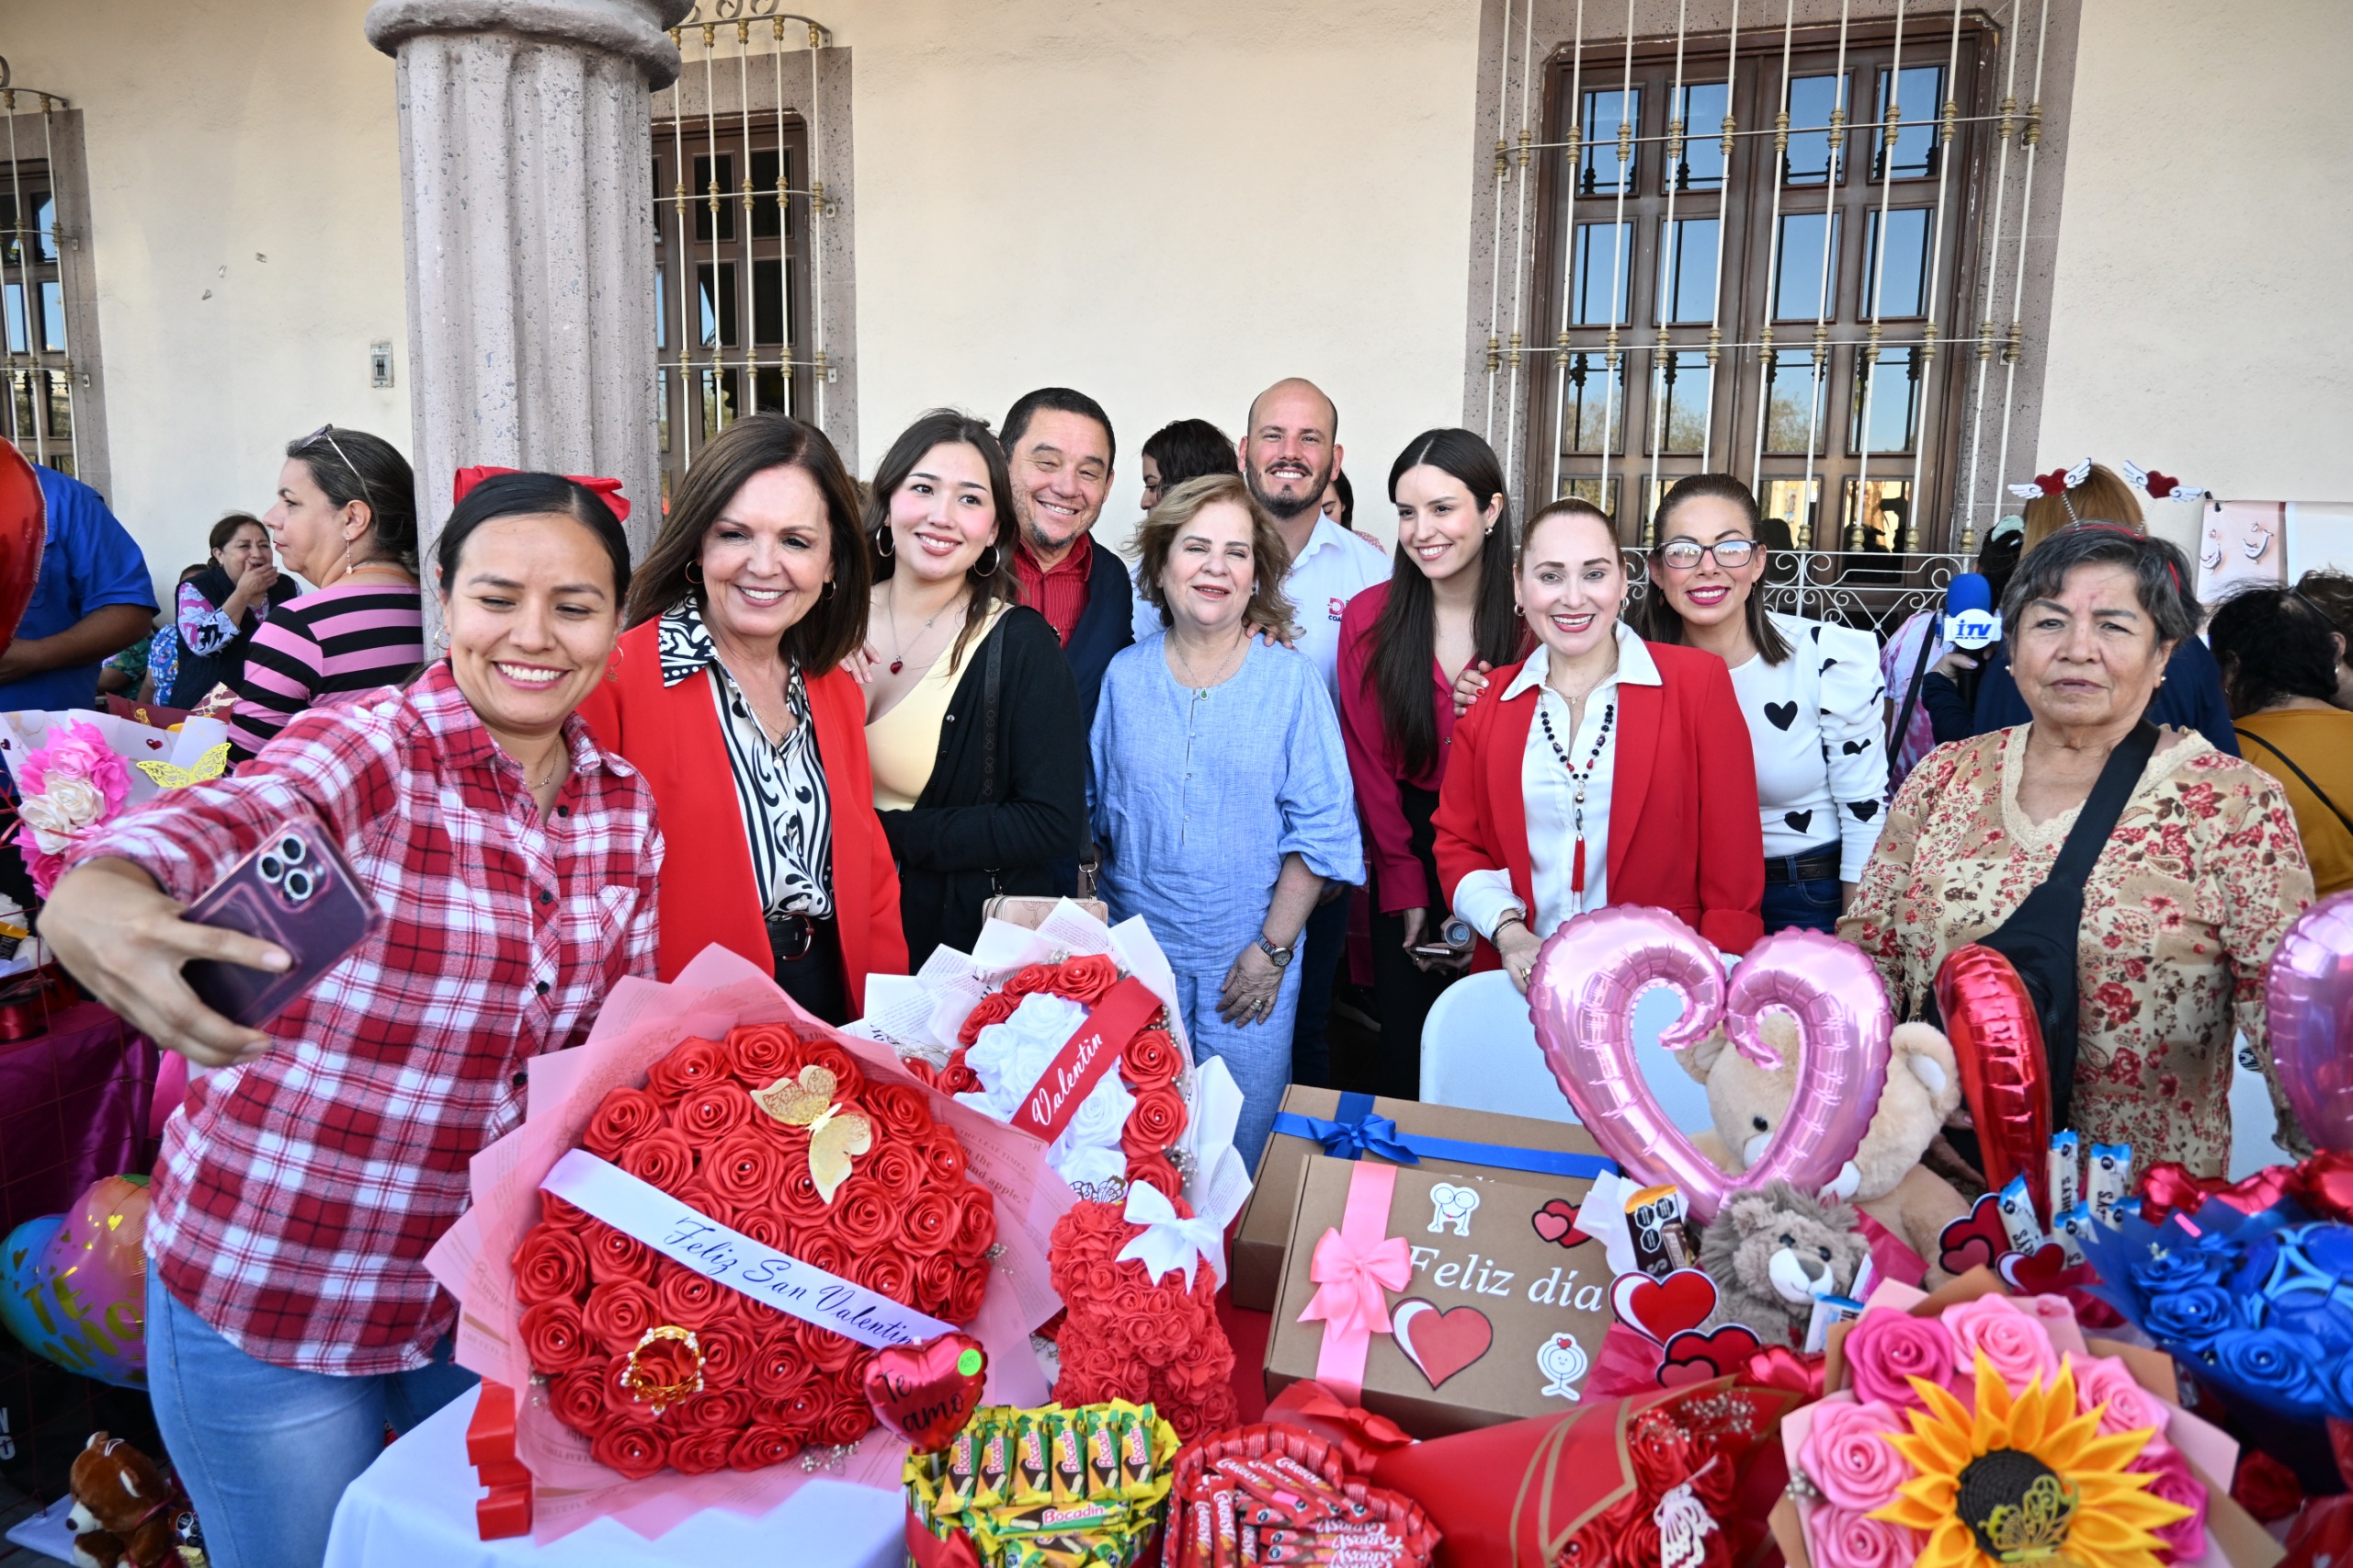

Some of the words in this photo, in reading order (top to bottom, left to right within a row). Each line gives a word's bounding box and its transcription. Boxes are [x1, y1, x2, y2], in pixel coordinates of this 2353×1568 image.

[1031, 1033, 1103, 1127] Valentin
[974, 1153, 994, 1169] the
[664, 1217, 738, 1276] Feliz
[743, 1259, 807, 1301] San
[815, 1284, 915, 1346] Valentin
[1410, 1245, 1515, 1297] Feliz
[1528, 1267, 1603, 1312] día
[873, 1369, 913, 1406] Te
[901, 1392, 965, 1435] amo
